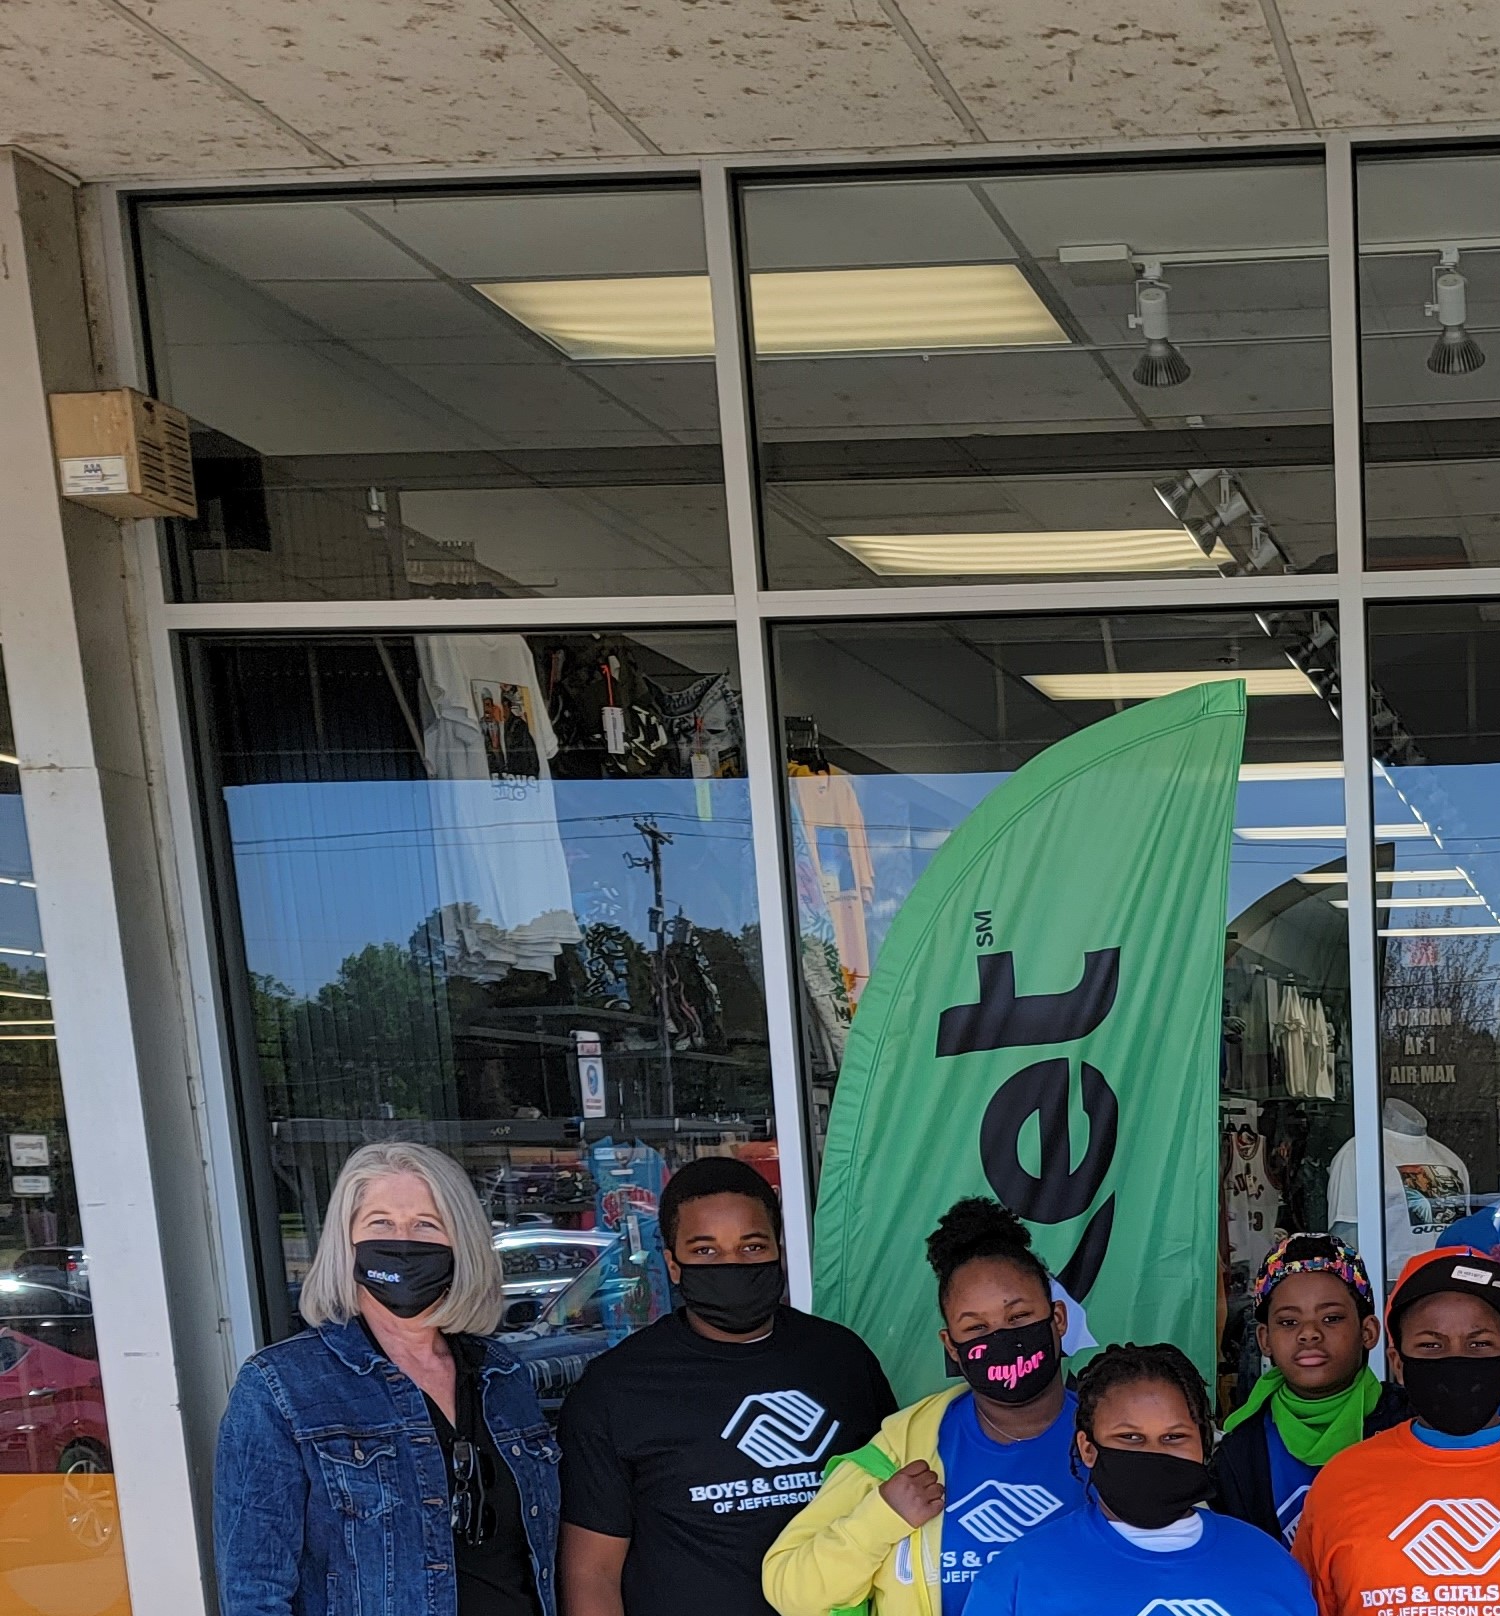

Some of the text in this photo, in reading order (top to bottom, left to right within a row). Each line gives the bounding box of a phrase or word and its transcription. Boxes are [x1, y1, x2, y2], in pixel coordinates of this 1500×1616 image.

[975, 909, 993, 948] SM
[1387, 1007, 1452, 1029] JORDAN
[1420, 1064, 1456, 1083] MAX
[689, 1481, 749, 1502] BOYS
[752, 1477, 772, 1494] &
[713, 1501, 734, 1514] OF
[961, 1550, 982, 1568] &
[1360, 1587, 1407, 1608] BOYS
[1411, 1585, 1430, 1603] &
[1434, 1585, 1500, 1602] GIRLS
